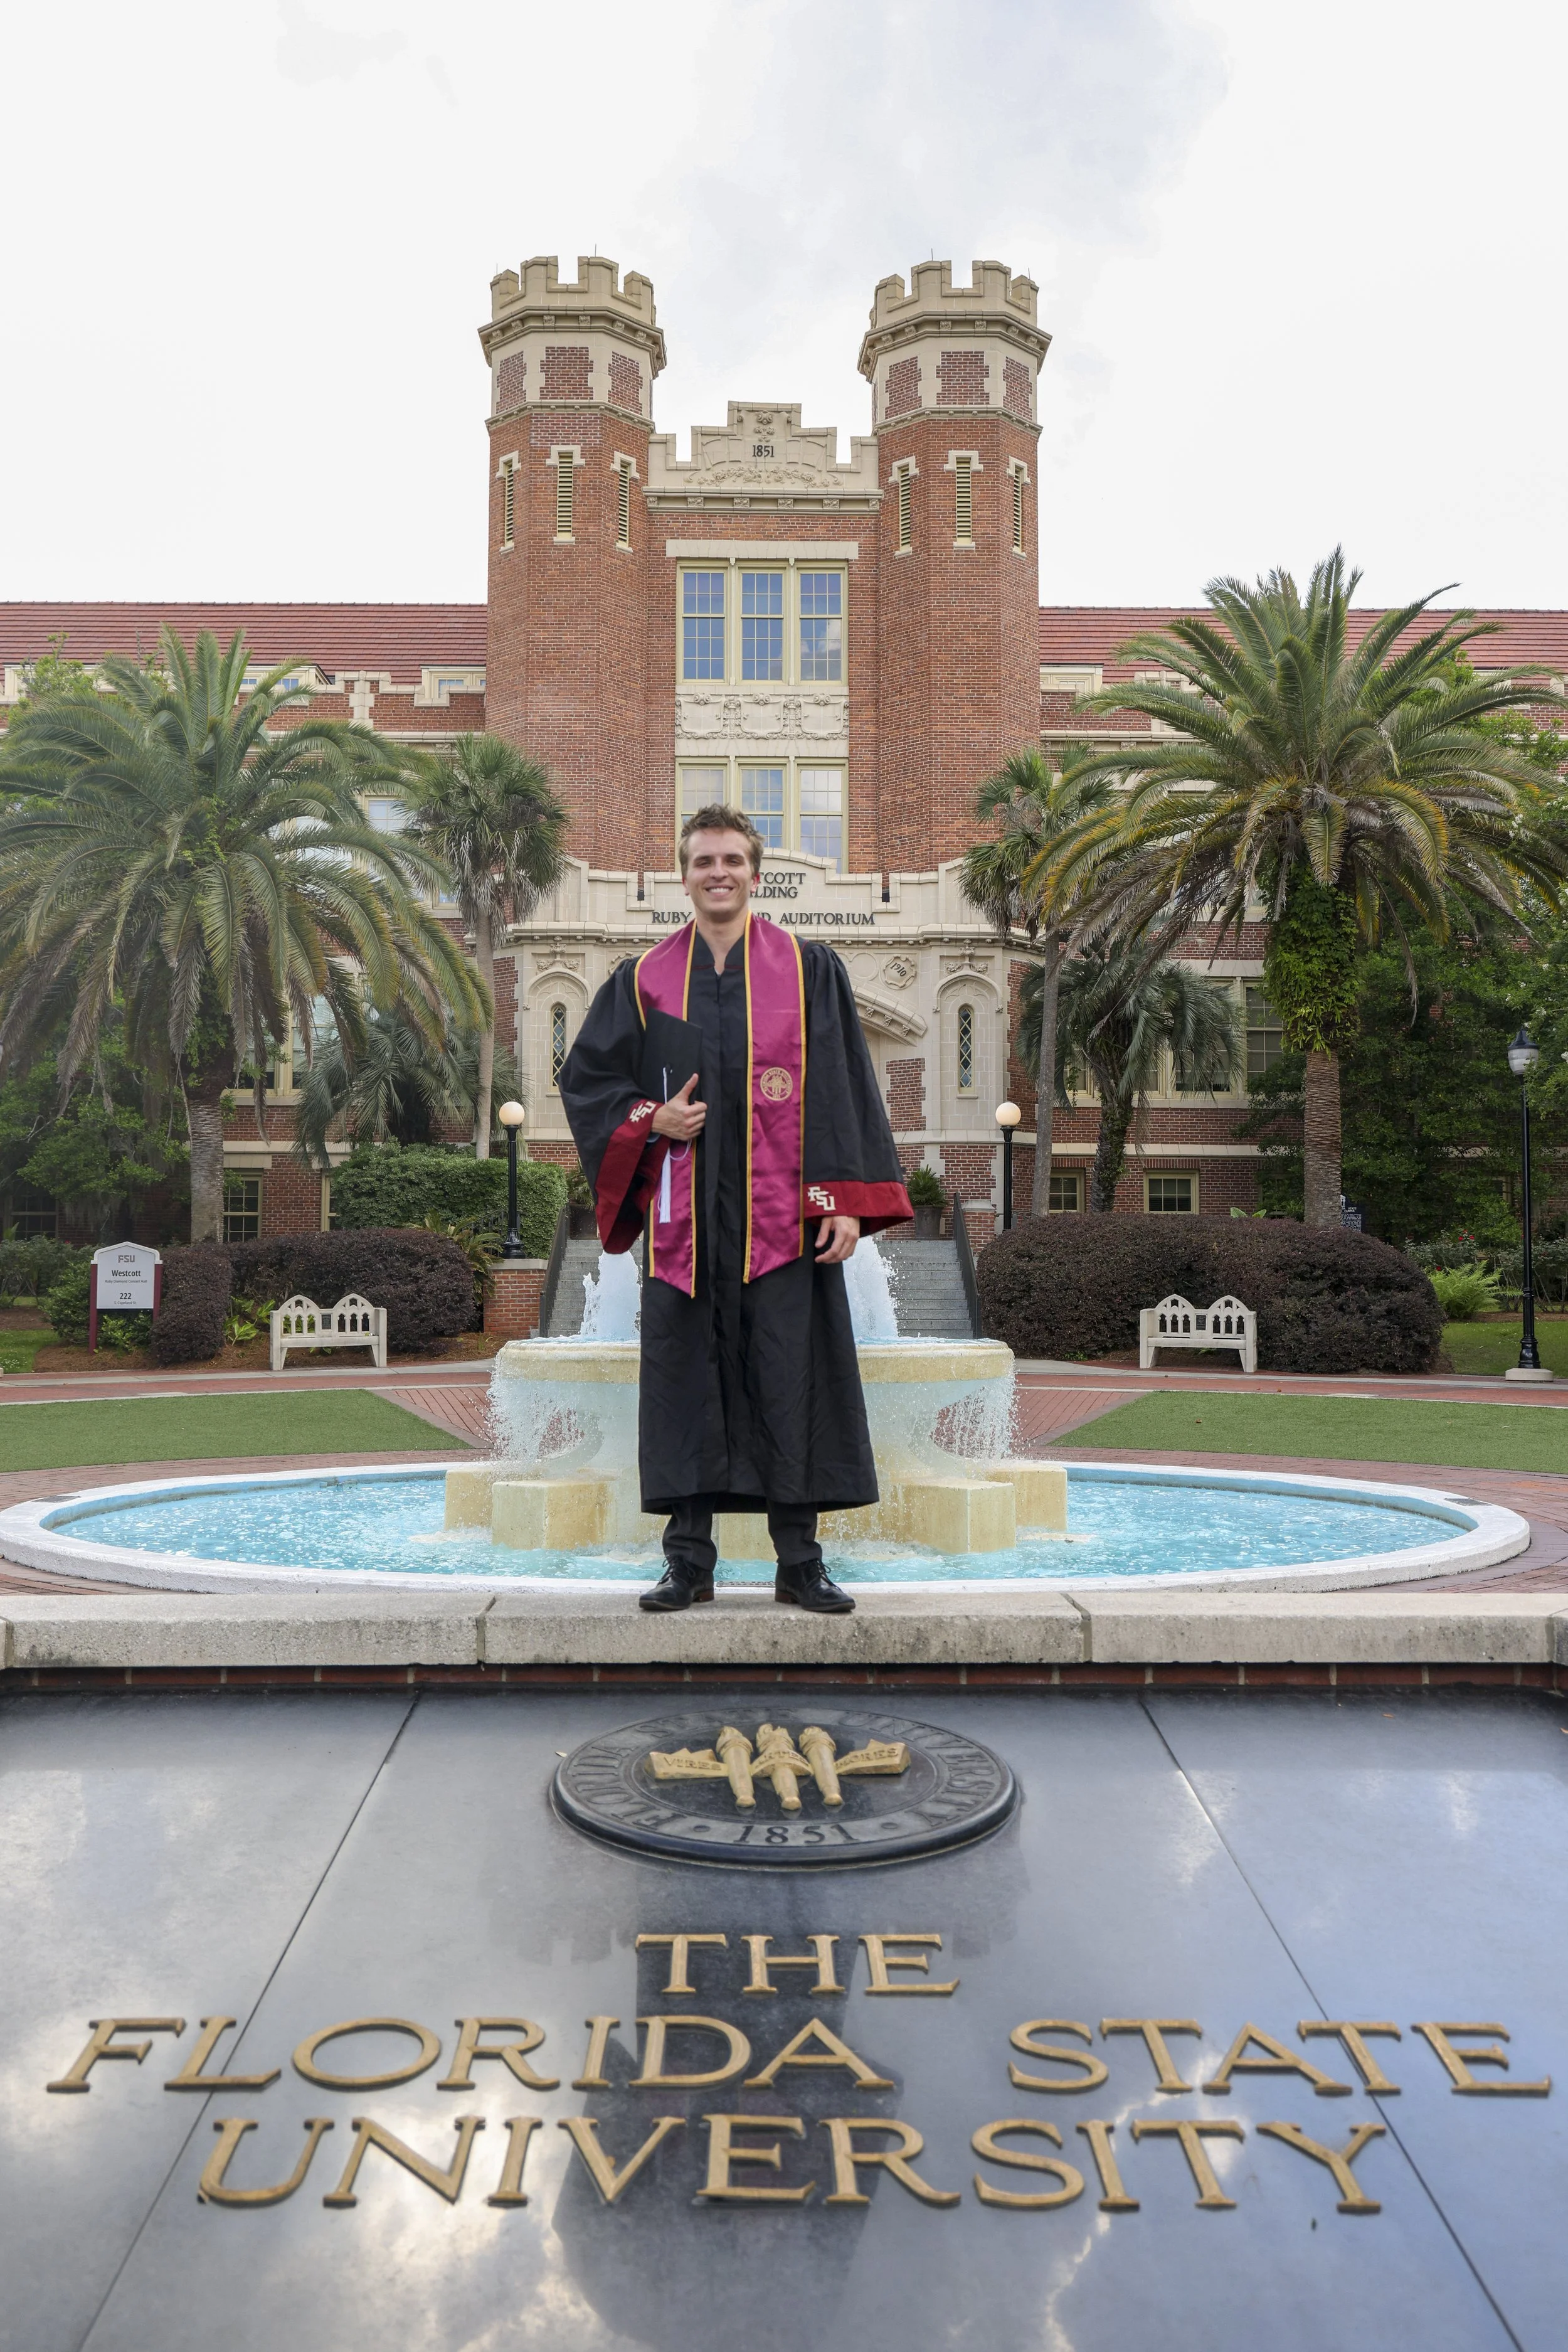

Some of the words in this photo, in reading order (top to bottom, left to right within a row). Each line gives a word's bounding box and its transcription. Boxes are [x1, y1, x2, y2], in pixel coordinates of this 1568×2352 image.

[752, 445, 775, 458] 1851
[652, 912, 692, 923] RUBY
[779, 912, 876, 925] AUDITORIUM
[889, 962, 907, 977] 1910
[629, 1101, 657, 1123] FSU
[807, 1186, 836, 1211] FSU
[118, 1255, 135, 1263] FSU
[664, 1756, 722, 1771] VIRES
[733, 1824, 861, 1844] 1851
[635, 1933, 961, 1996] THE
[46, 2015, 895, 2092] FLORIDA
[1009, 2018, 1552, 2096] STATE
[197, 2114, 1386, 2212] UNIVERSITY
